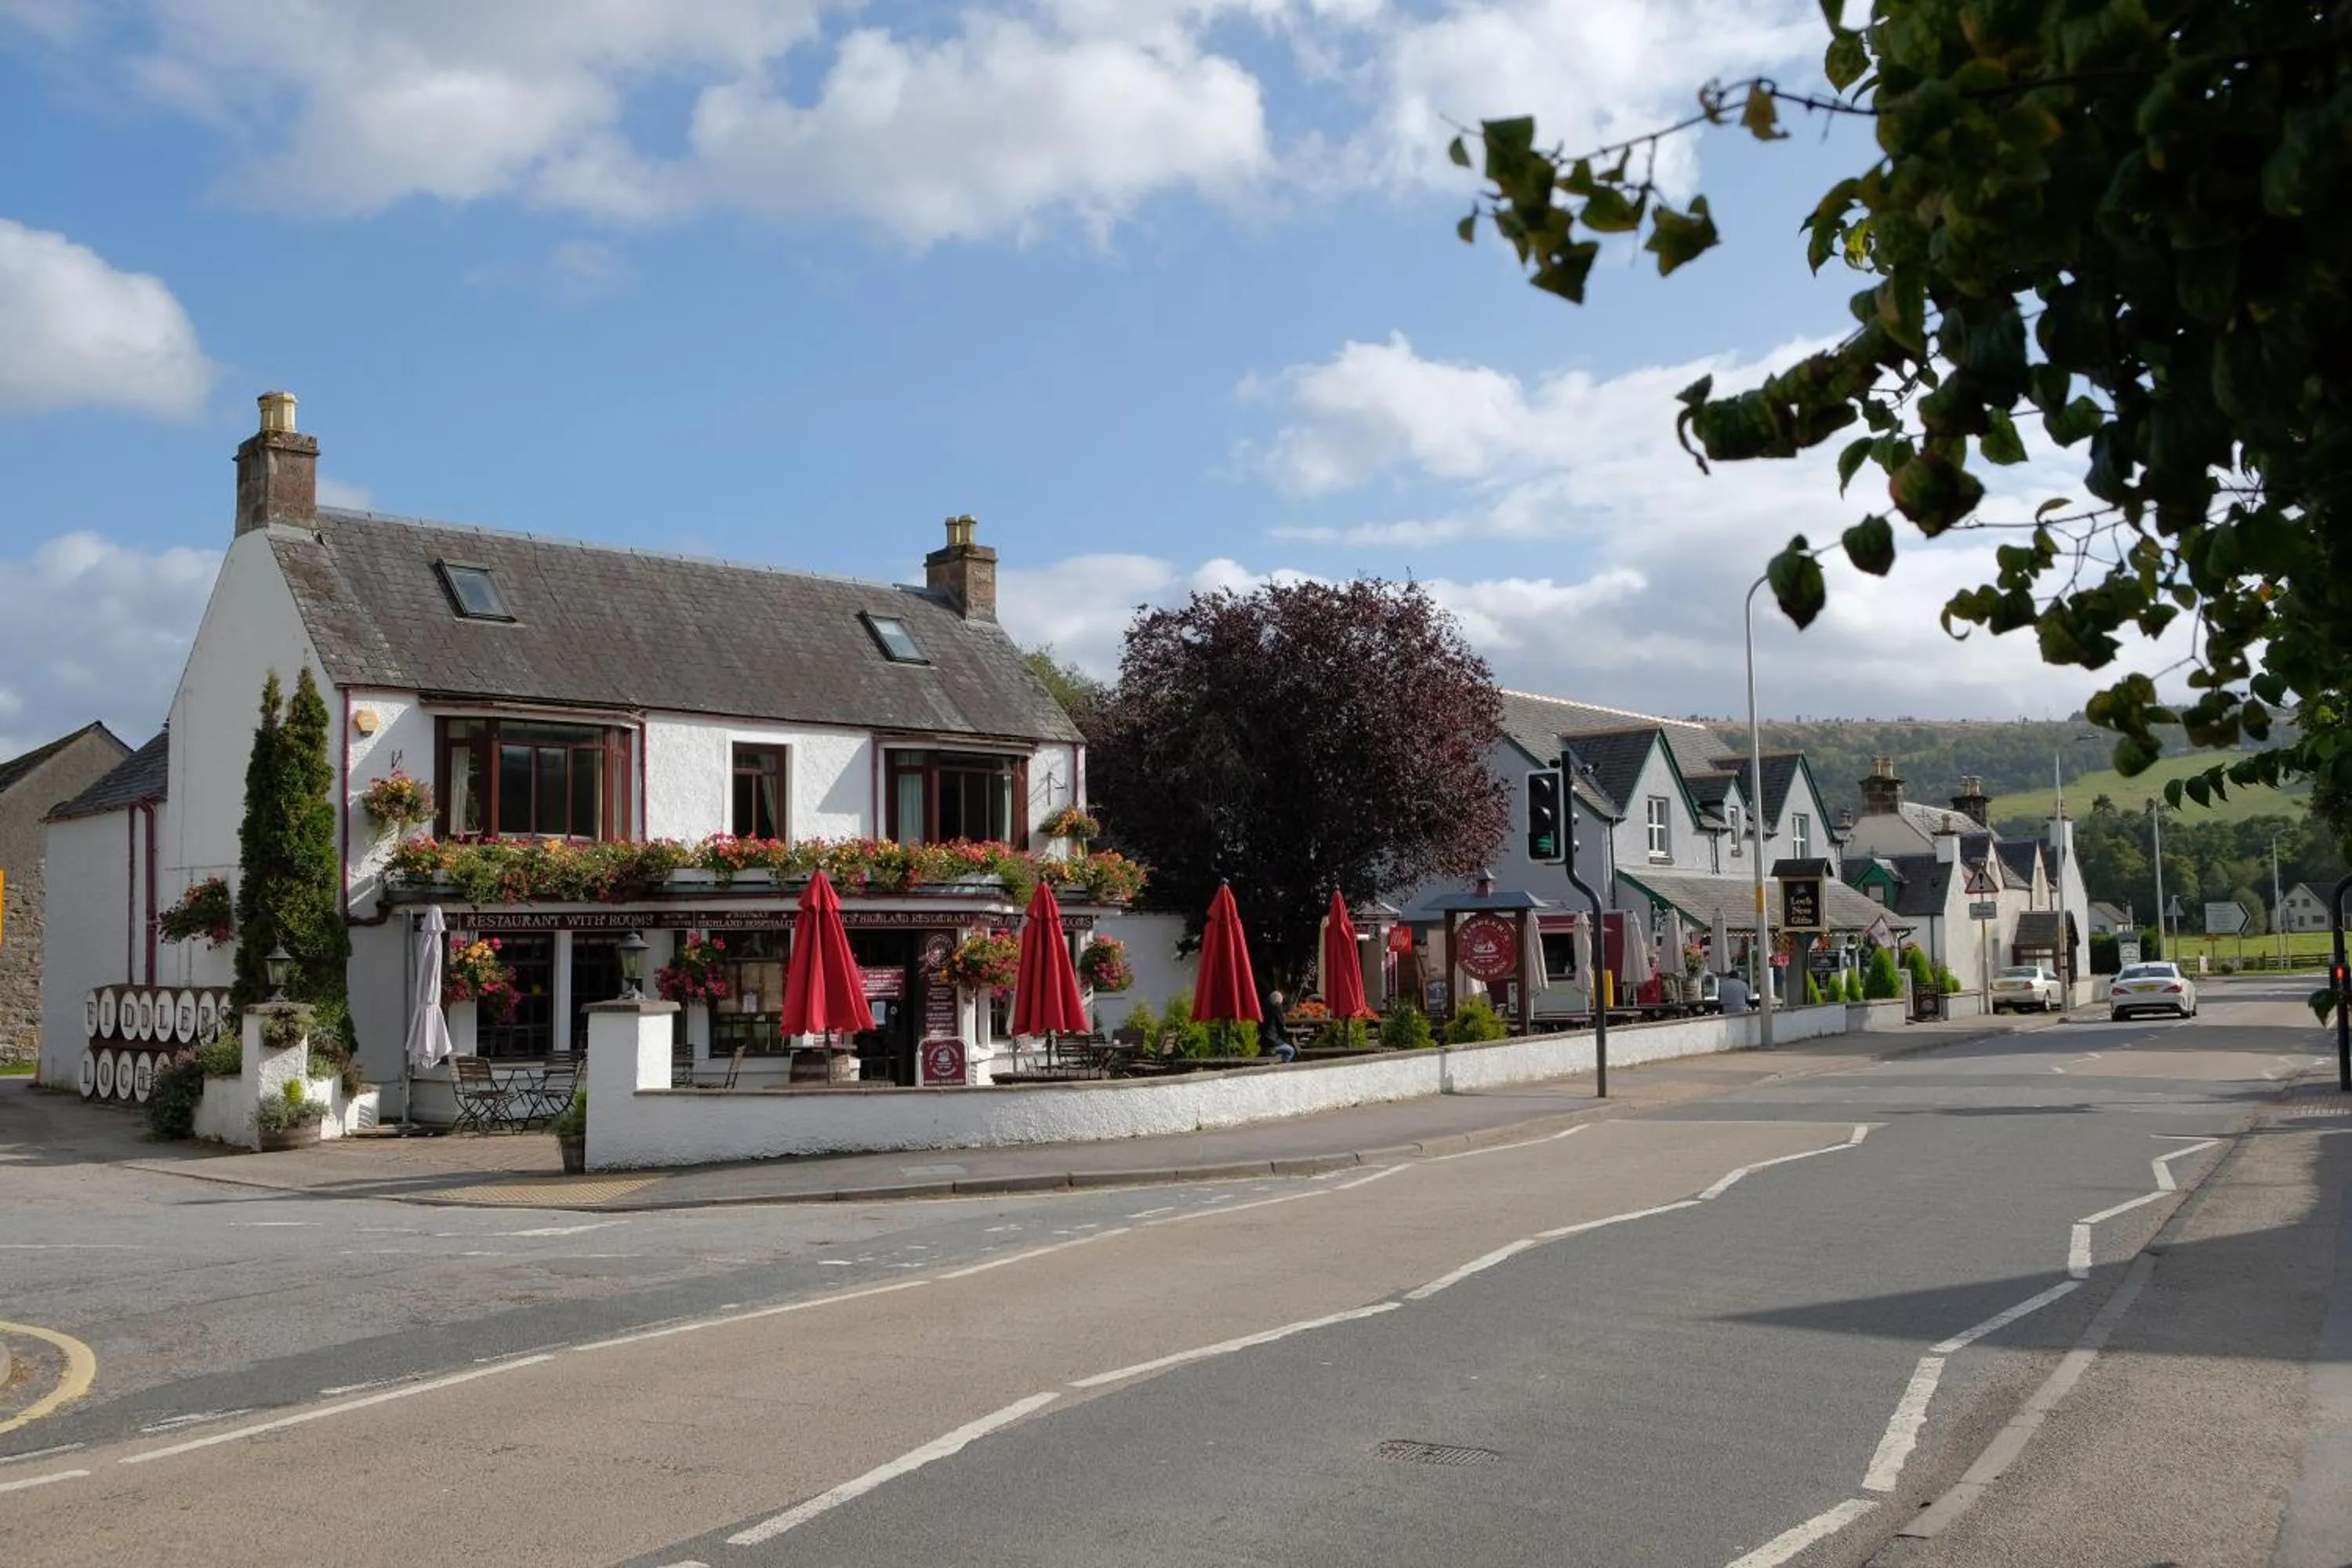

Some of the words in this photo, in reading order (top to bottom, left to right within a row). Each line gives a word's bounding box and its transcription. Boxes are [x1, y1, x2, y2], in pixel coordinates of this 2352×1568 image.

[466, 915, 561, 927] RESTAURANT
[565, 915, 605, 926] WITH
[609, 914, 655, 926] ROOMS
[697, 919, 743, 928] HIGHLAND
[912, 913, 971, 924] RESTAURANT
[83, 1060, 152, 1091] LOCH
